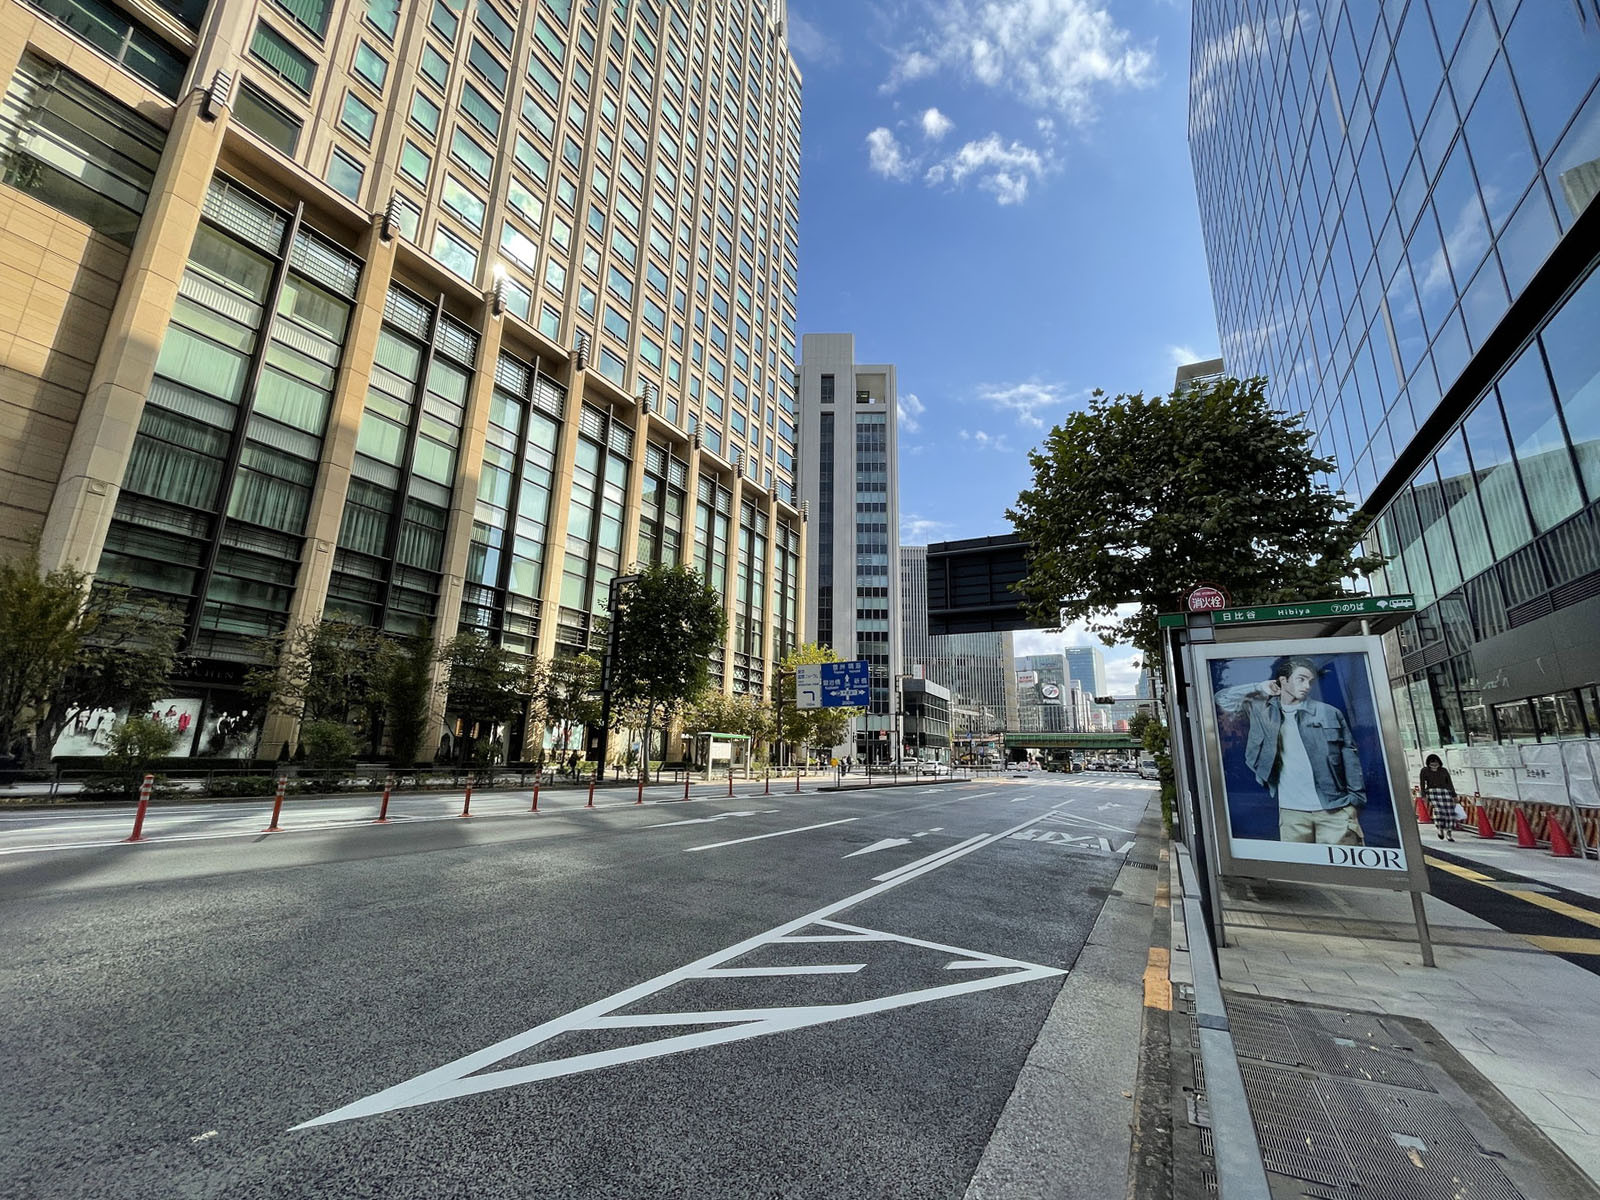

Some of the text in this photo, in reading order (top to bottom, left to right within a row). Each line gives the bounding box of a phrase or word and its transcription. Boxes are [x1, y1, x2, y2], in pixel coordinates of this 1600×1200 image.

[1192, 596, 1222, 609] 消火栓
[1223, 610, 1256, 621] 日比谷
[1277, 607, 1311, 616] Hibiya
[1327, 846, 1404, 869] DIOR
